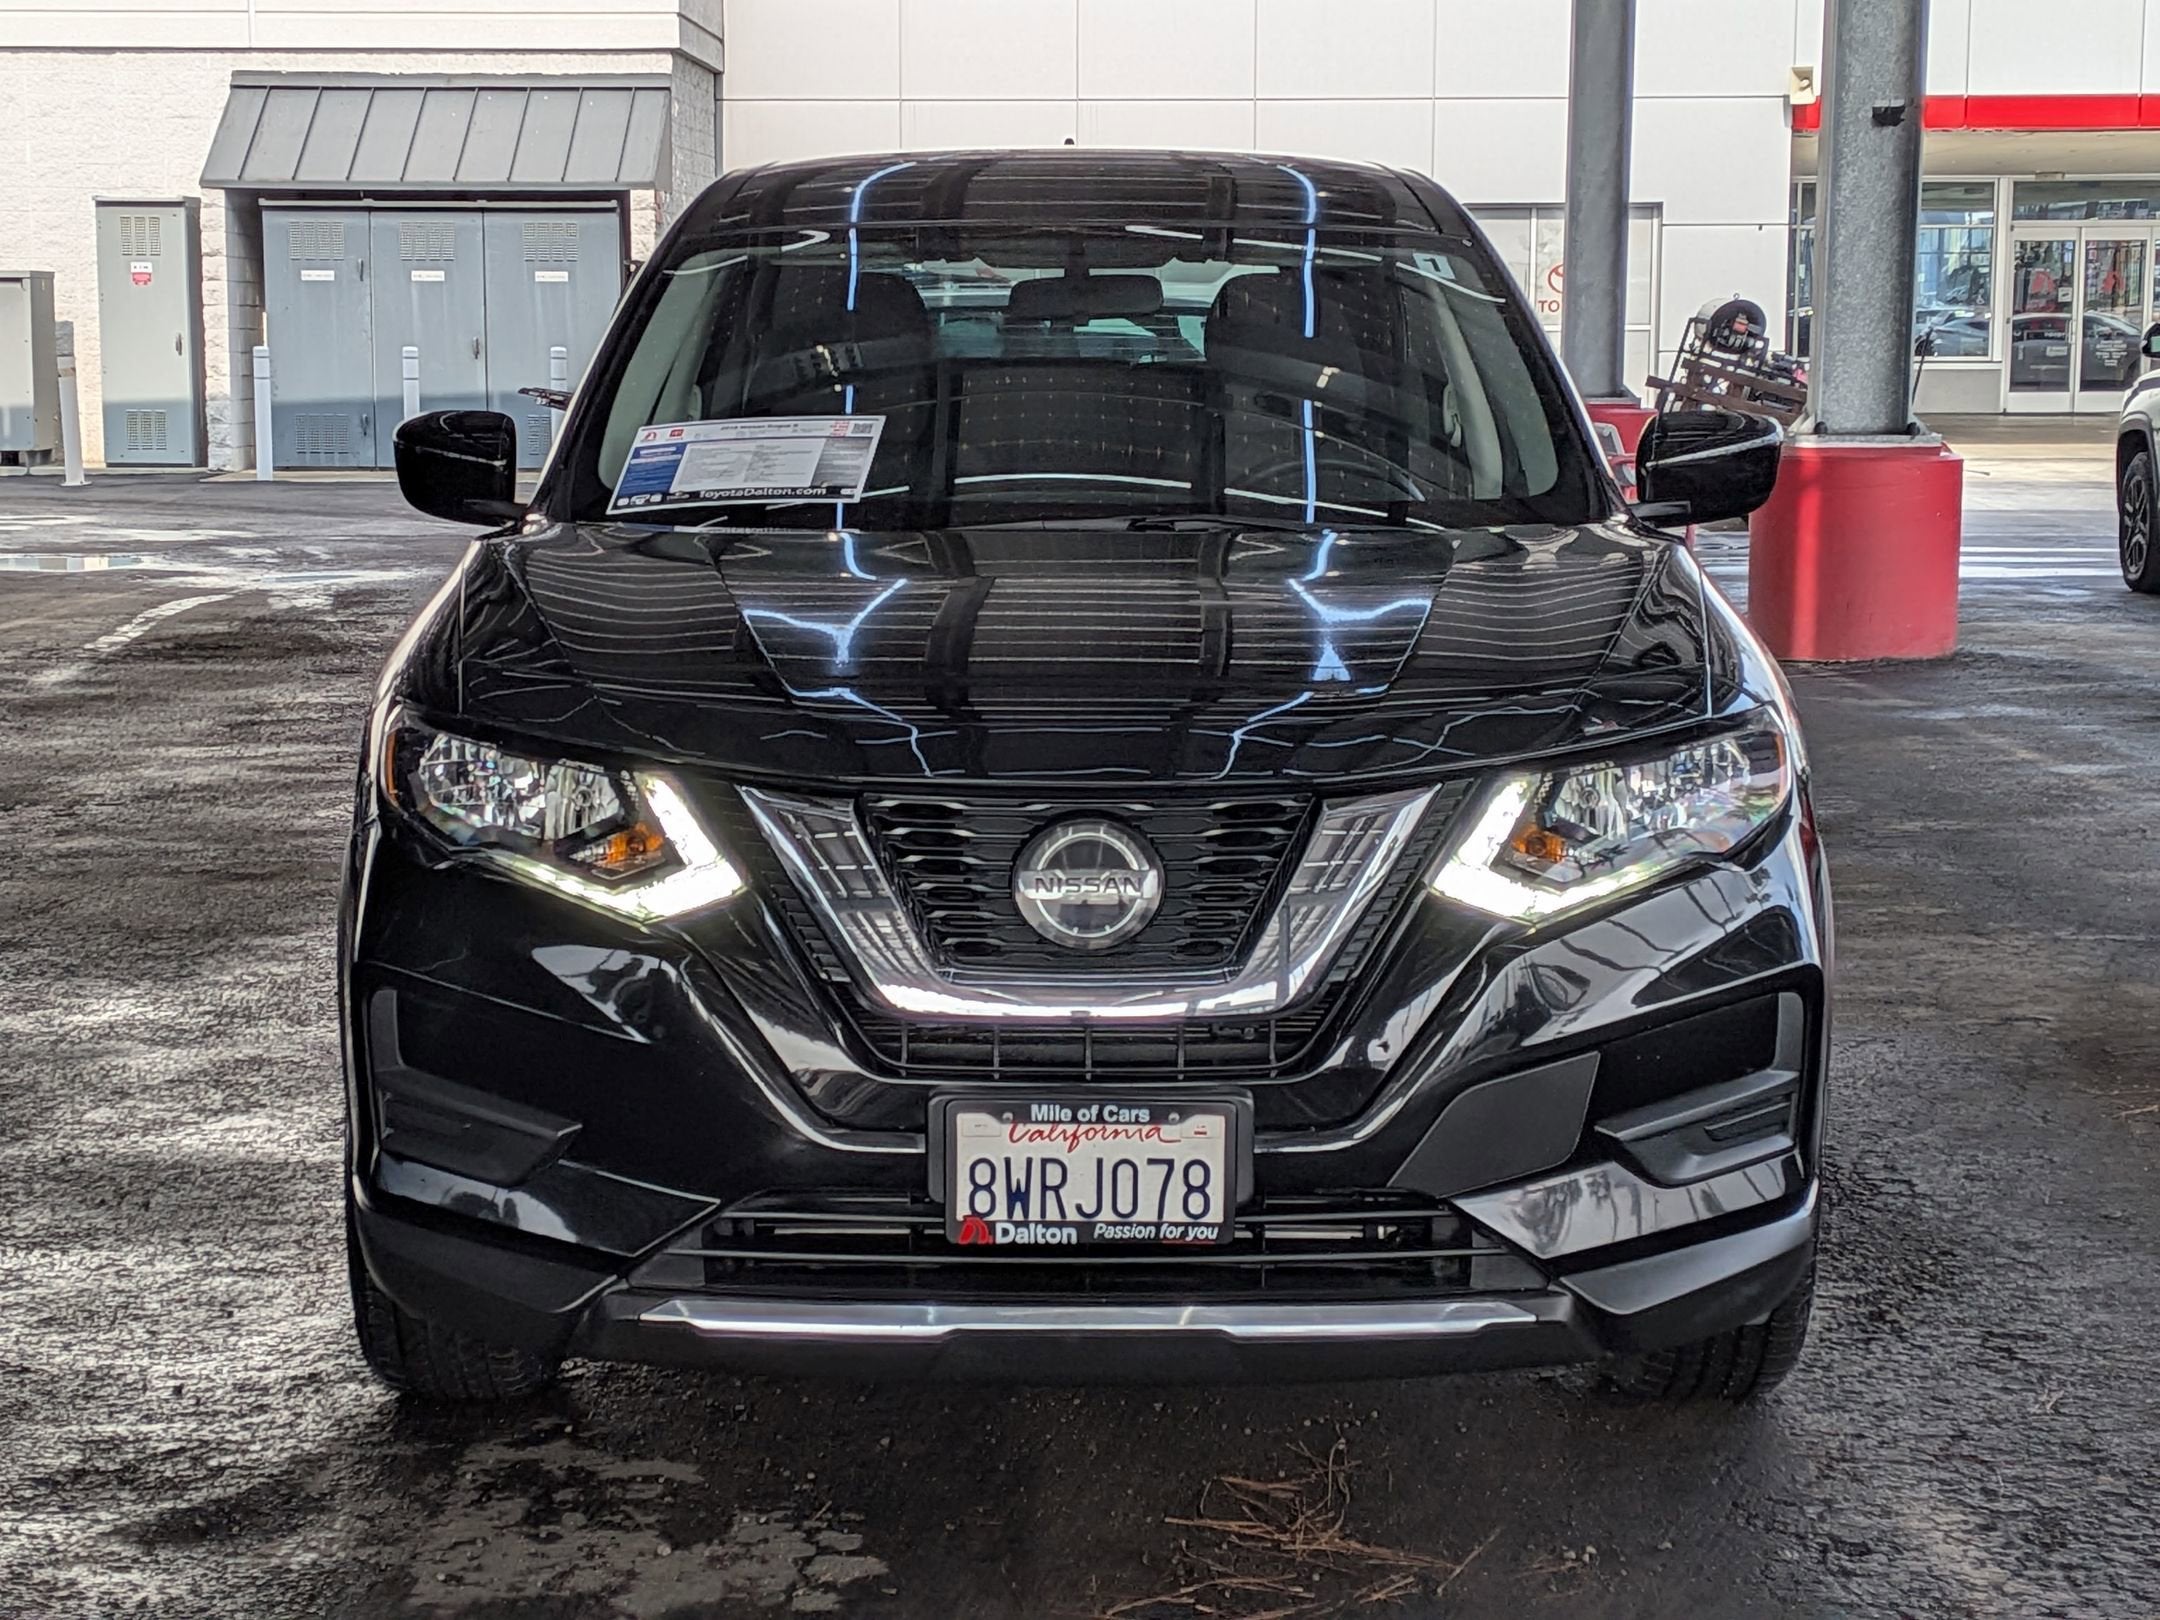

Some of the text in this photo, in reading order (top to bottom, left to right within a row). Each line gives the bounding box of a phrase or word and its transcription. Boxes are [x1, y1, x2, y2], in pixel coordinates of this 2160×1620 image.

[1538, 300, 1560, 313] TO
[699, 487, 827, 500] ToyotaDalton.com
[1034, 877, 1141, 893] NISSAN
[1031, 1104, 1150, 1123] Mile of Cars
[1009, 1122, 1182, 1153] California
[969, 1156, 1211, 1220] 8WRJ078
[995, 1222, 1078, 1245] Dalton
[1093, 1223, 1219, 1241] Passion for you
